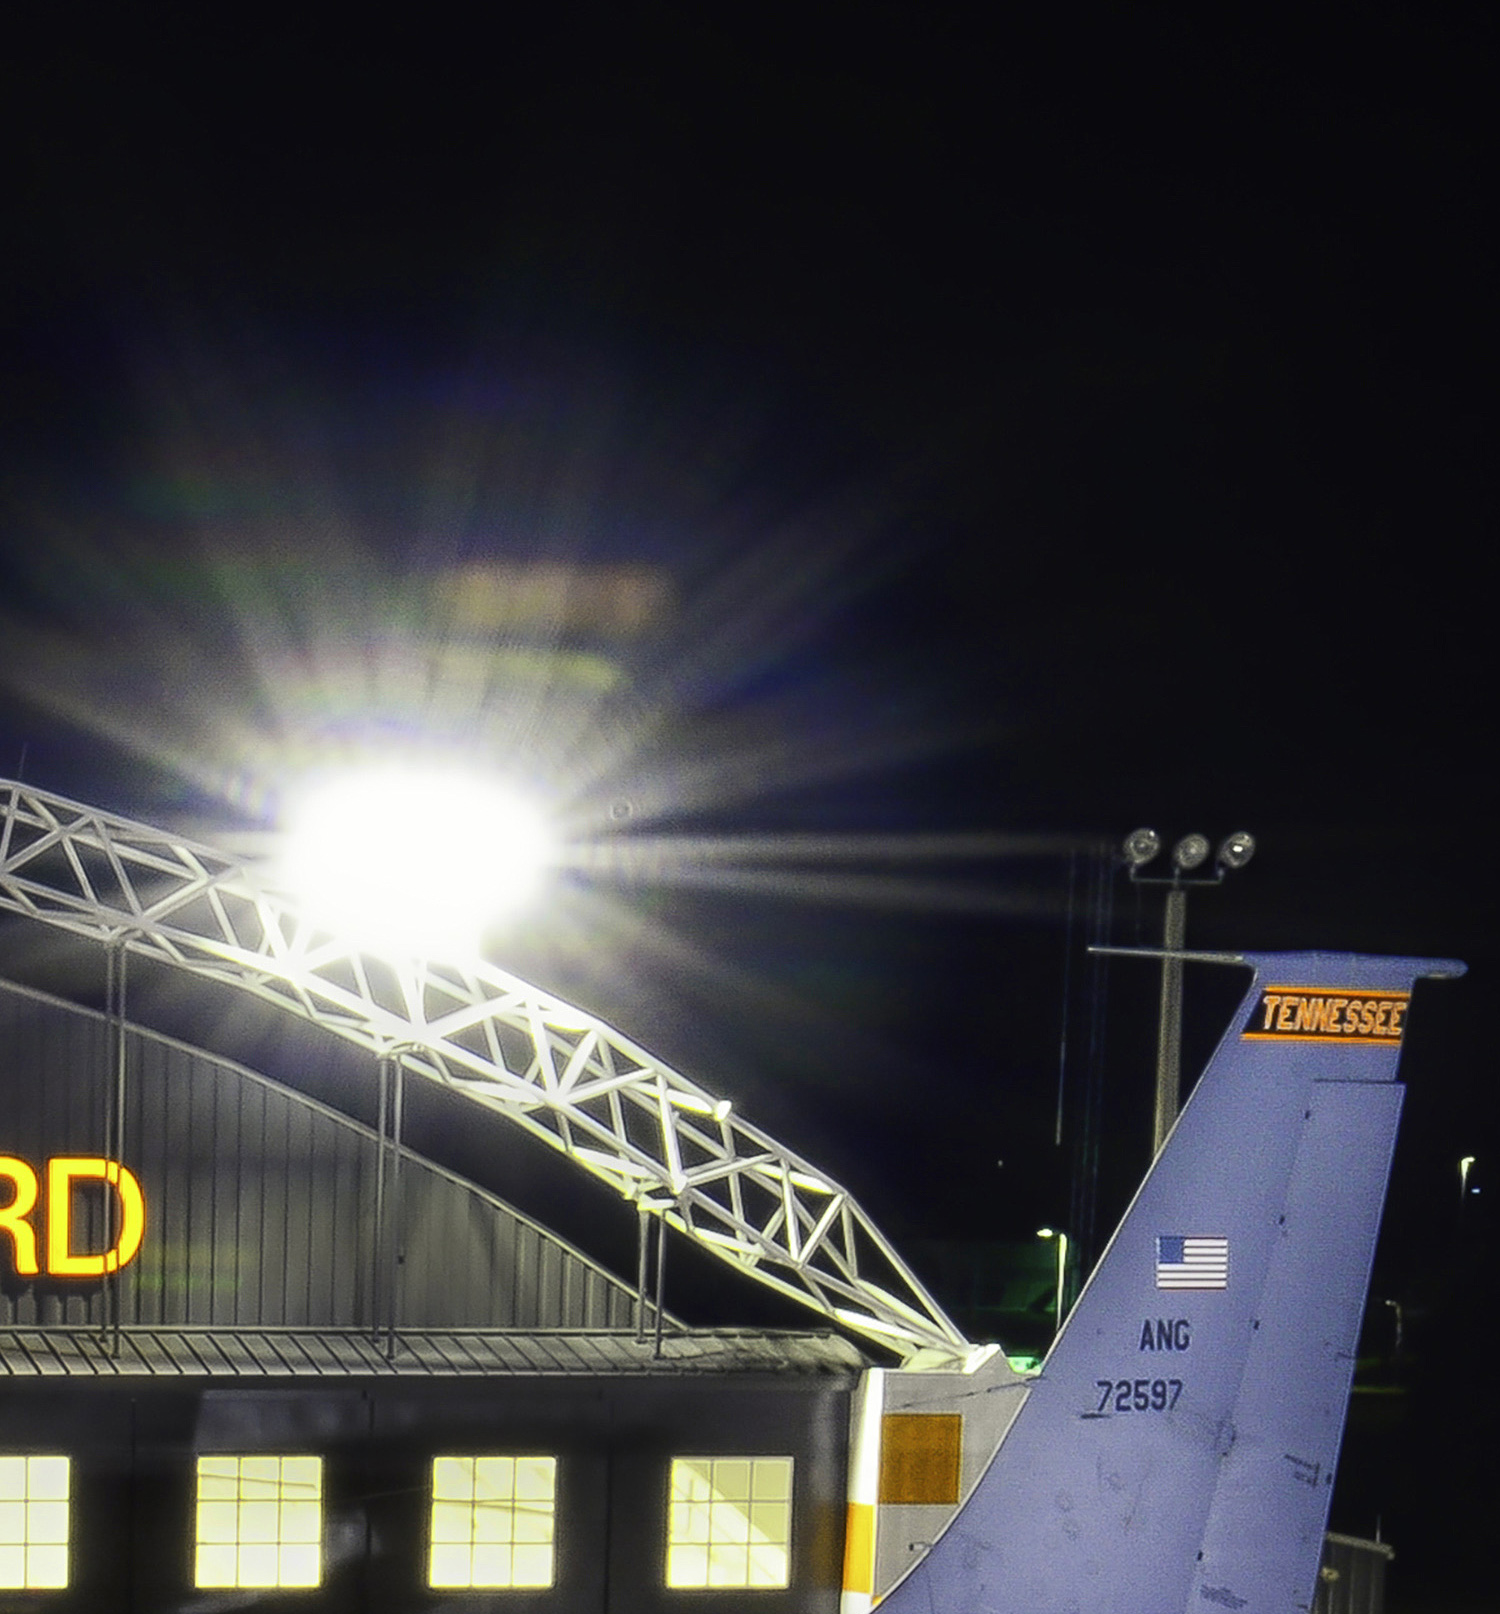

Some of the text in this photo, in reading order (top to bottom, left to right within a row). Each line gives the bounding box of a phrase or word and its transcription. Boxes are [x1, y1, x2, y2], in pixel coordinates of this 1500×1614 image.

[1262, 995, 1408, 1036] TENNESSEE
[1139, 1319, 1191, 1351] ANG
[1097, 1379, 1184, 1411] 72597
